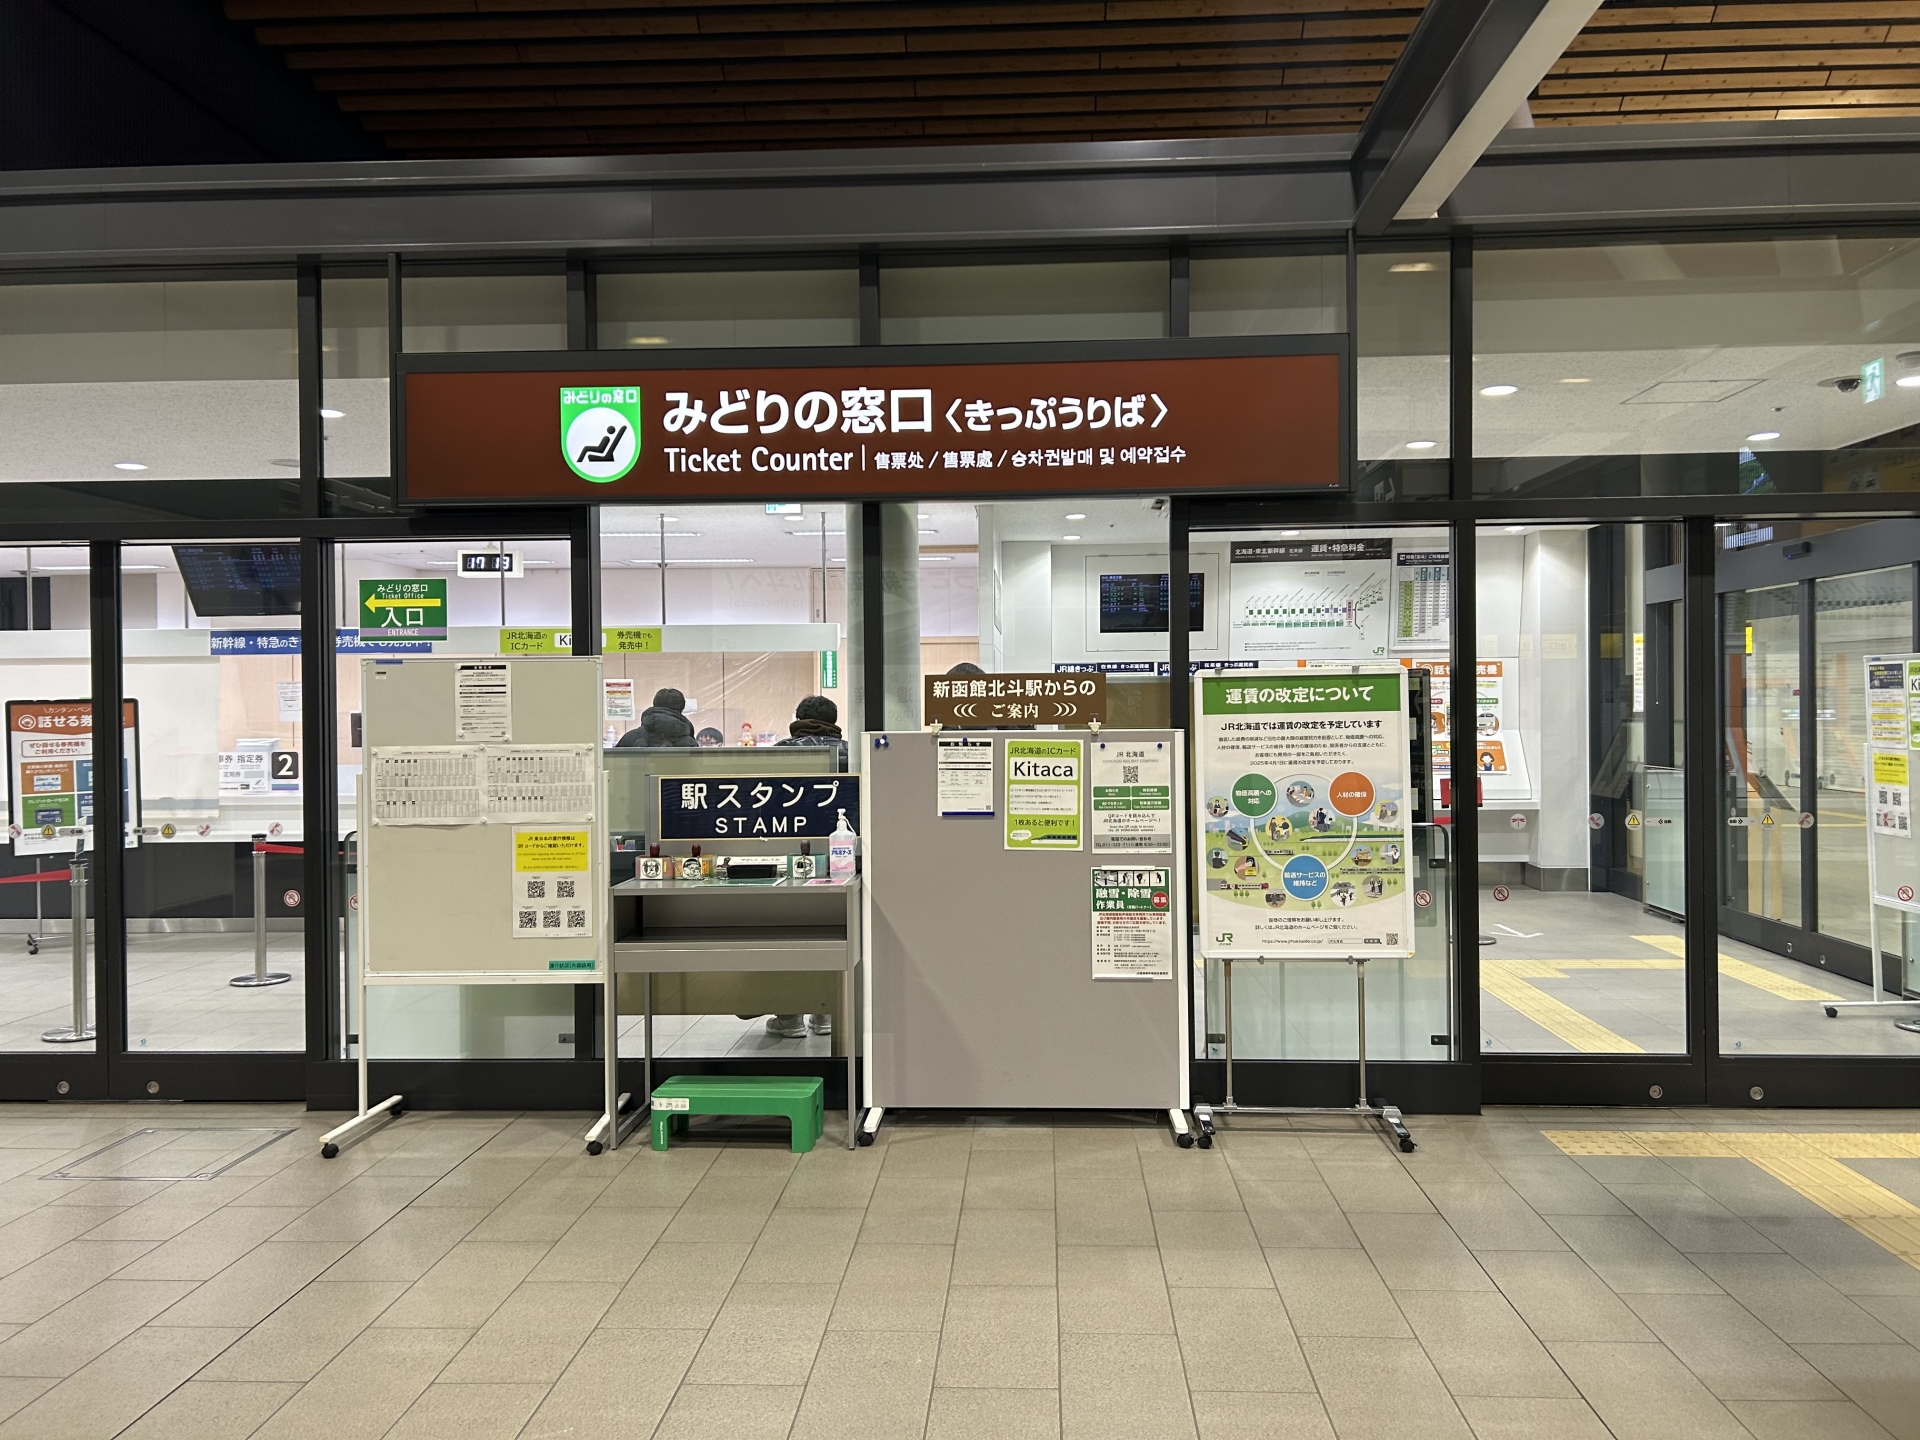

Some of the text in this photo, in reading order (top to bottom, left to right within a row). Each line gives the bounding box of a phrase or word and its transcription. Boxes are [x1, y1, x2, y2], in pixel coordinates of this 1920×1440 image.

[563, 389, 637, 404] みどりの窓口
[663, 387, 932, 435] みどりの窓口
[663, 446, 854, 473] Ticket Counter
[874, 451, 925, 470] 售票处
[943, 450, 993, 469] 售票處
[1011, 445, 1187, 468] 승차권발매 및 예약접수
[1311, 543, 1365, 553] 運賃・特急料金
[467, 557, 484, 569] 17
[377, 583, 428, 592] みどりの窓口
[381, 607, 424, 627] 入口
[387, 628, 419, 636] ENTRANCE
[506, 631, 547, 640] JR北海道の
[617, 630, 653, 639] 券売機でも
[510, 642, 544, 650] ICカード
[933, 679, 1097, 699] 新函館北斗駅からの
[1225, 685, 1374, 704] 運賃の改定について
[991, 702, 1039, 718] ご案内
[1221, 720, 1382, 731] JR北海道では運賃の改定を予定しています
[1010, 747, 1076, 755] JR北海道のICカード
[237, 755, 263, 763] 指定券
[277, 754, 294, 776] 2
[1014, 761, 1073, 777] Kitaca
[681, 780, 840, 809] 駅スタンプ
[1235, 789, 1272, 797] 物価高騰への
[1336, 791, 1367, 799] 人材の確保
[1248, 797, 1260, 805] 対応
[715, 816, 807, 834] STAMP
[1015, 819, 1075, 827] 1枚あると便利です！
[1284, 871, 1325, 879] 輸送サービスの
[1096, 900, 1124, 909] 作業員
[1216, 933, 1234, 943] JR
